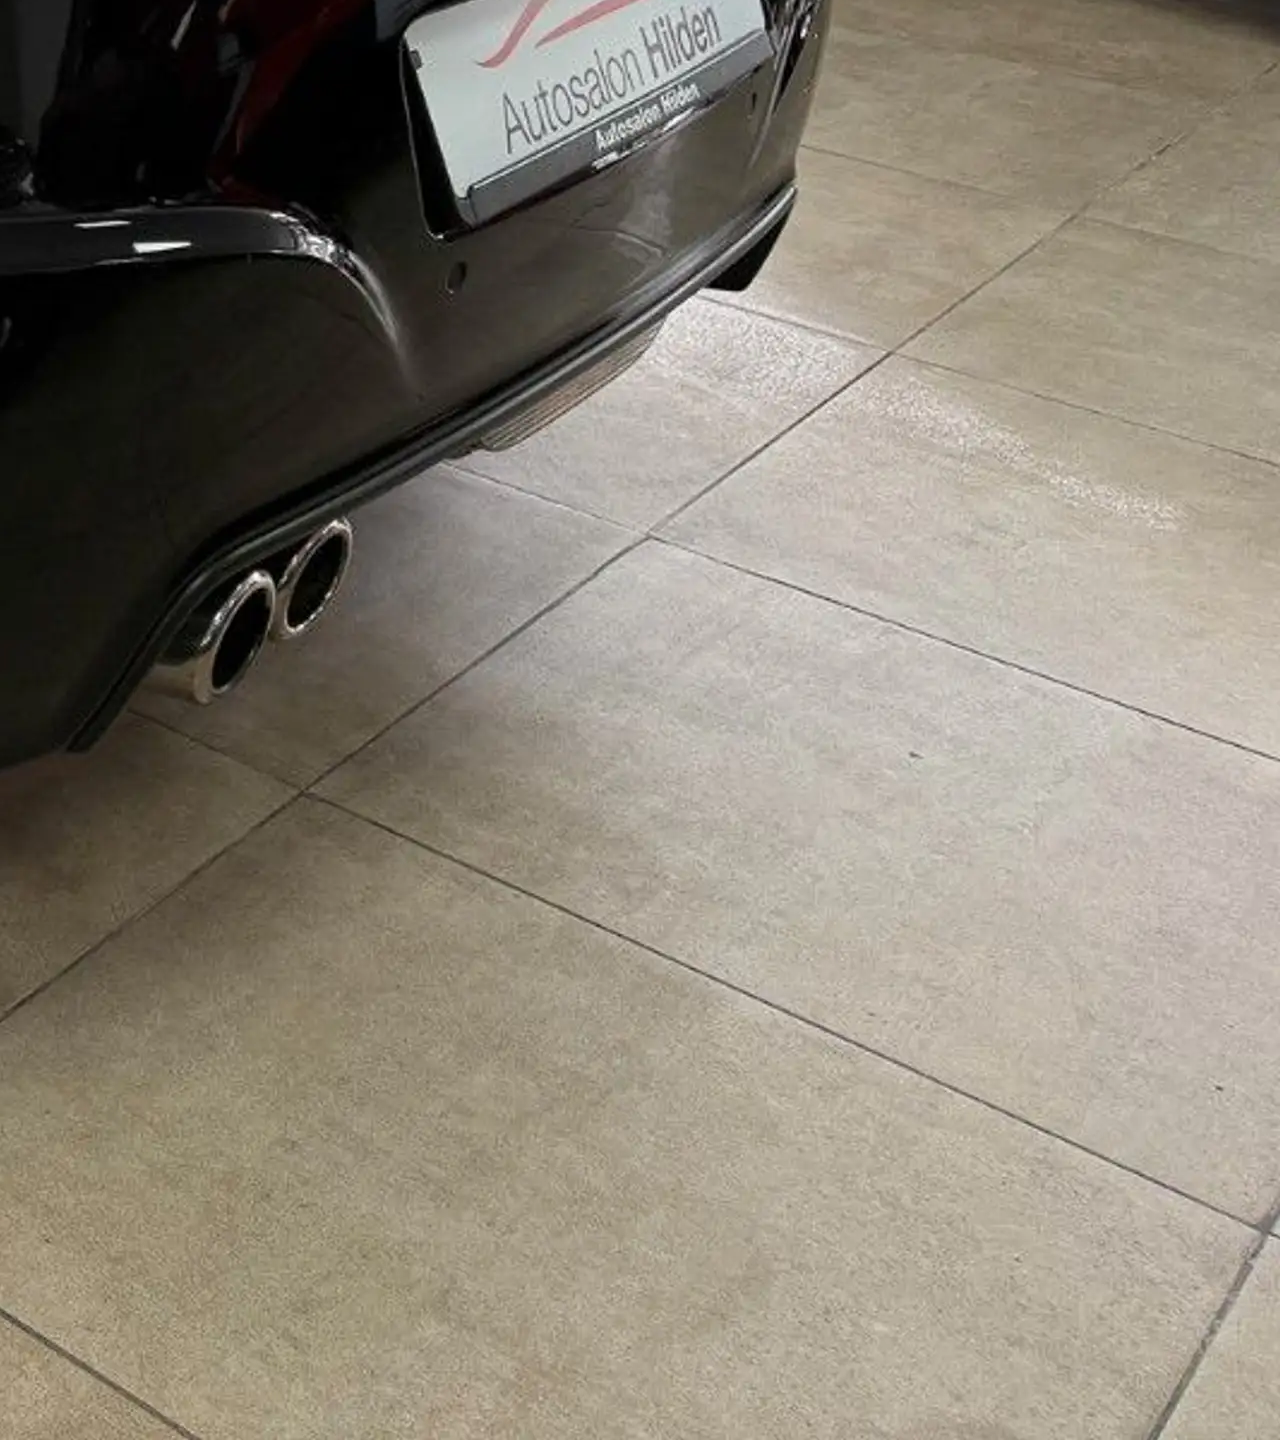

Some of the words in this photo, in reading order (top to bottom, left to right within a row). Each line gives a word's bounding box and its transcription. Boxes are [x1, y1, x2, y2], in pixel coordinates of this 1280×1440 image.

[503, 48, 645, 155] Autosalon
[640, 5, 722, 78] Hilden
[594, 103, 663, 152] Autosalon
